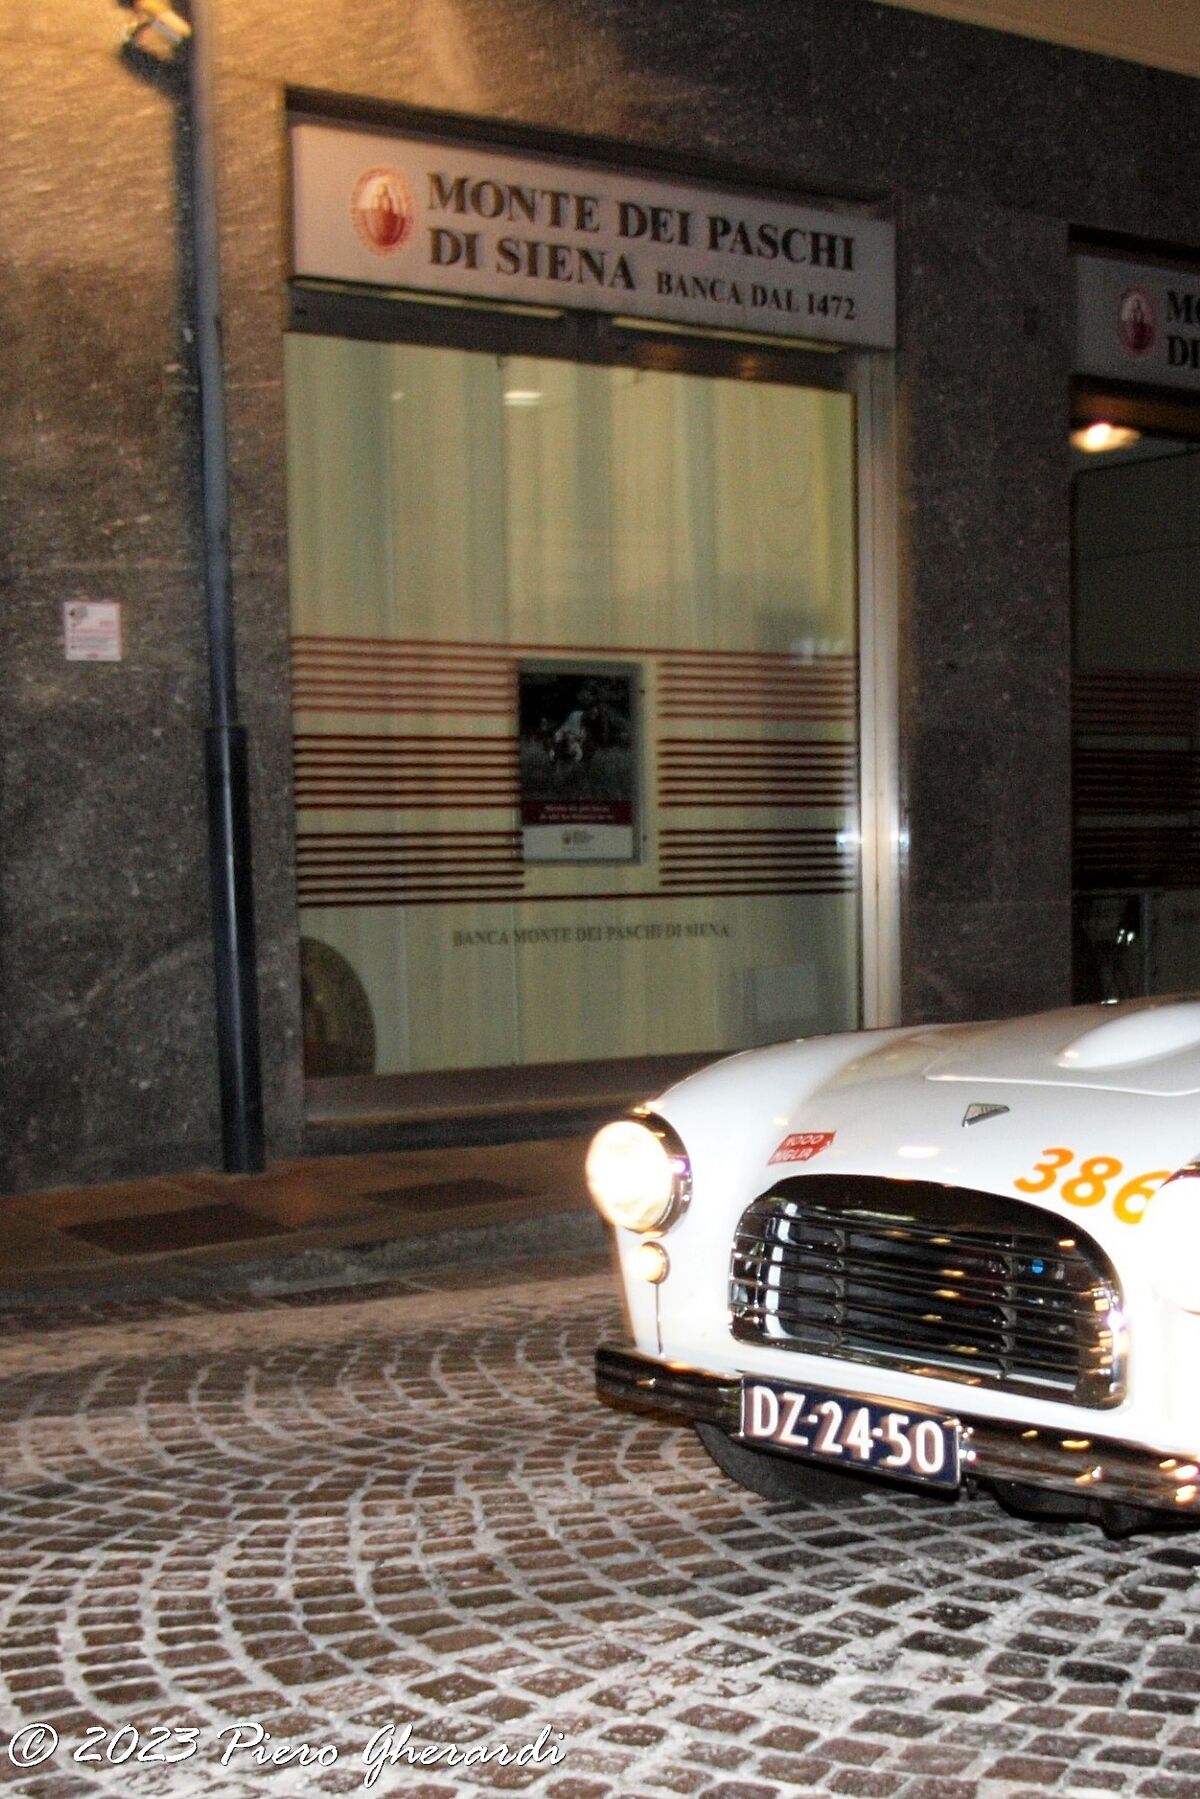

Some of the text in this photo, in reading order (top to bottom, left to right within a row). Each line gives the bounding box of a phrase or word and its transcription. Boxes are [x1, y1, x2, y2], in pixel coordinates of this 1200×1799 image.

[427, 172, 855, 272] MONTE DEI PASCHI
[429, 228, 857, 321] DI SIENA BANCA DAL 1472
[452, 929, 510, 947] BANCA
[513, 926, 571, 945] MONTE
[575, 925, 602, 943] DEI
[606, 922, 662, 942] PASCHI
[685, 921, 730, 939] SIENA
[1013, 1148, 1171, 1225] 386
[752, 1385, 944, 1474] DZ-24-50
